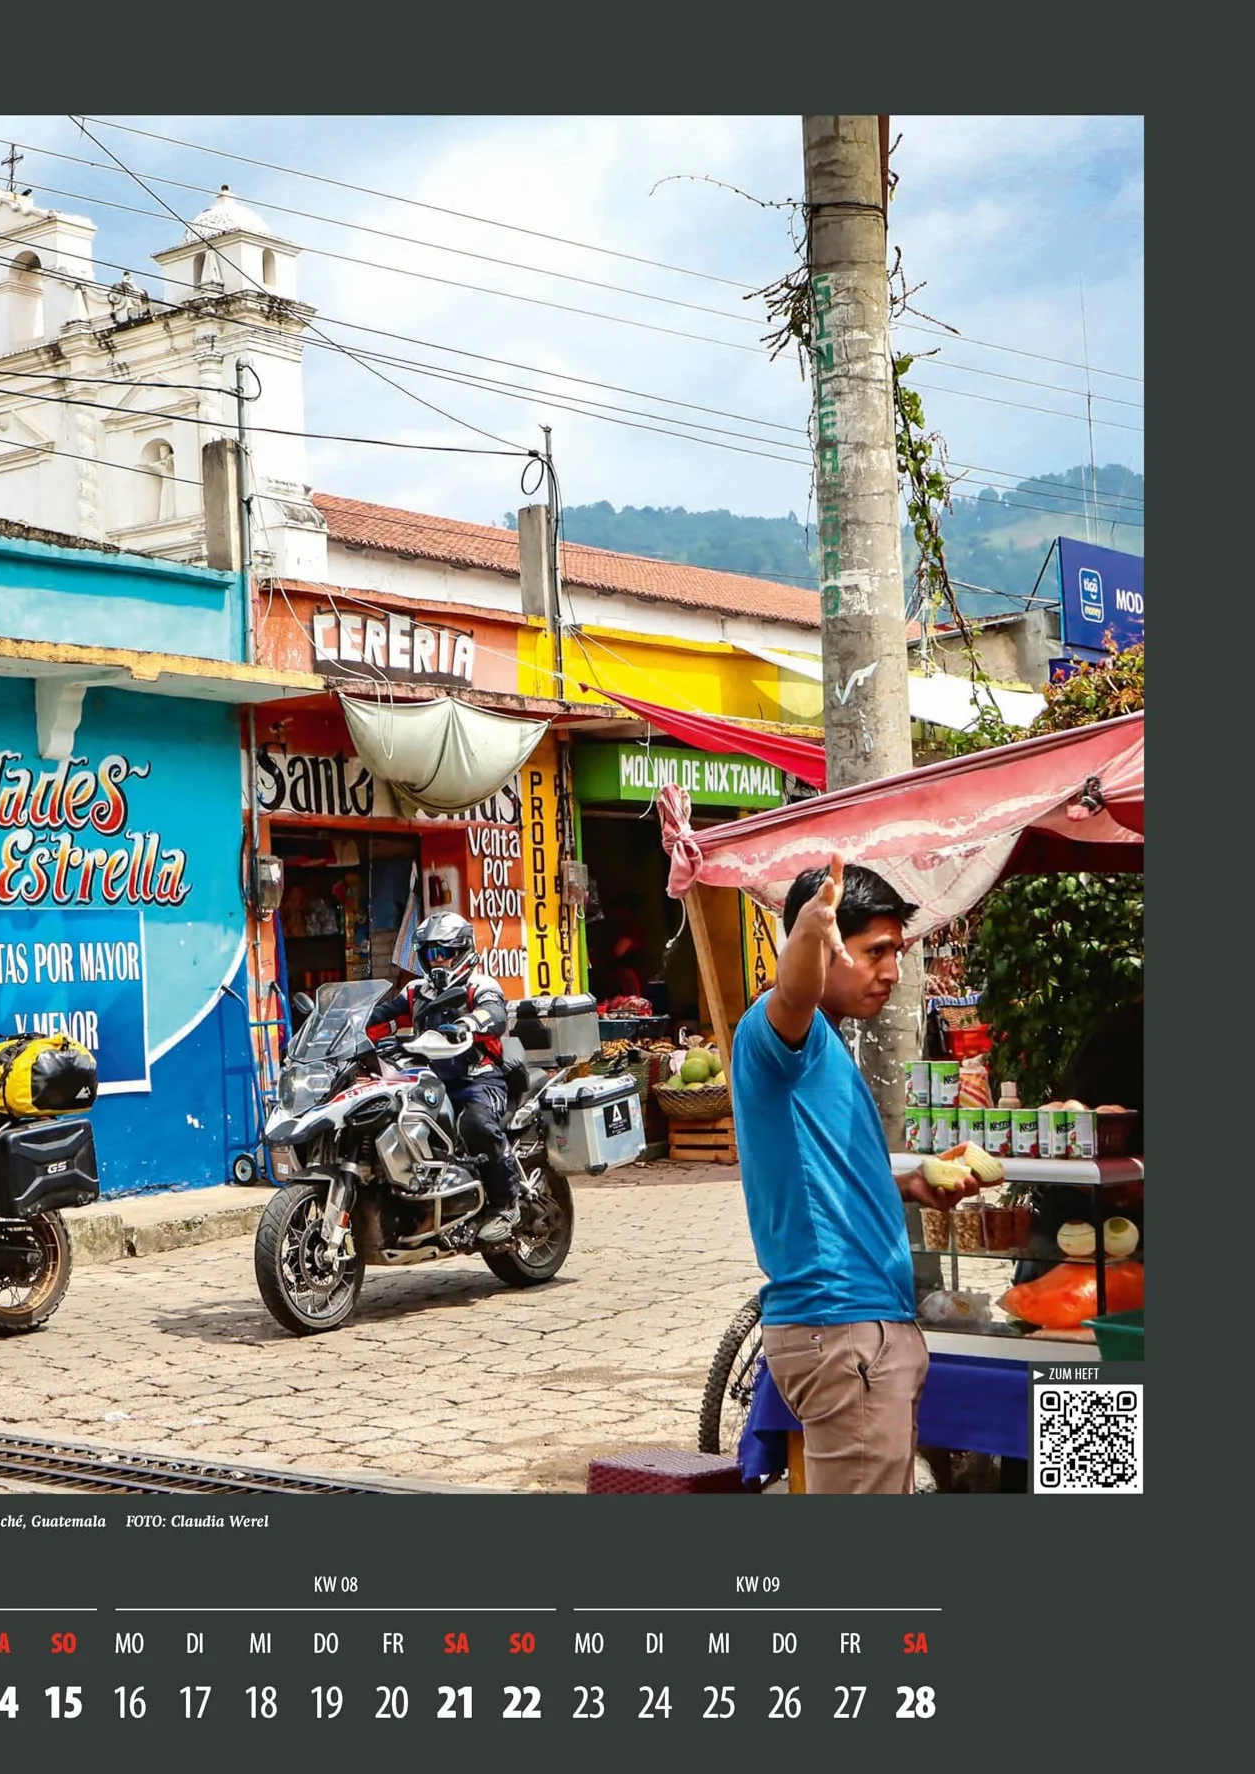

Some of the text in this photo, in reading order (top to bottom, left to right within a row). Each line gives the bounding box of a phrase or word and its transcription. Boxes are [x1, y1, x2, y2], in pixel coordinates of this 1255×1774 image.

[682, 760, 701, 792] DE
[704, 762, 781, 797] NIXTAMAL
[530, 770, 552, 997] PRODUCTO
[34, 941, 76, 983] POR
[79, 940, 141, 983] MAYOR
[47, 1161, 67, 1174] GS
